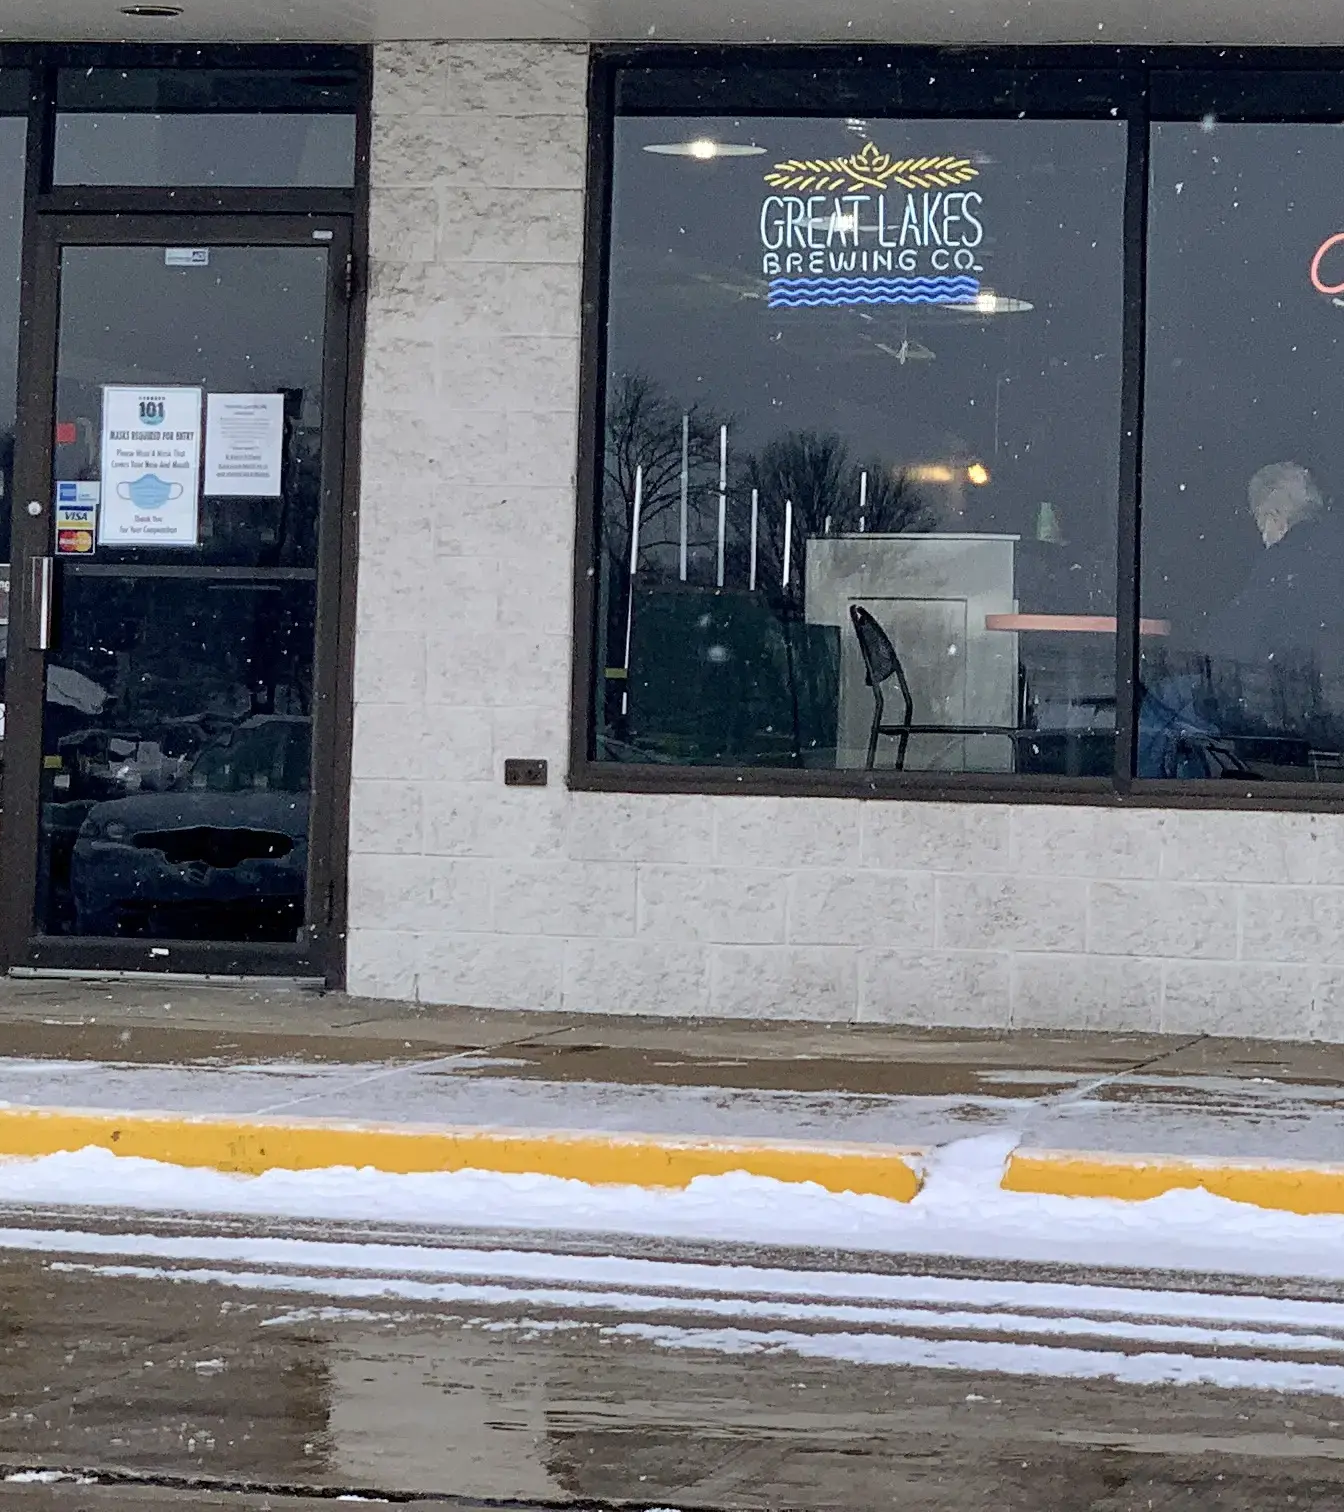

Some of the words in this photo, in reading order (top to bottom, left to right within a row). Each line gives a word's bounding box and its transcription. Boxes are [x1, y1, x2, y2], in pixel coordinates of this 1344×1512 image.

[760, 194, 871, 249] GREAT
[878, 191, 983, 248] LAKES
[763, 249, 917, 274] BREWING
[65, 511, 87, 521] VISA
